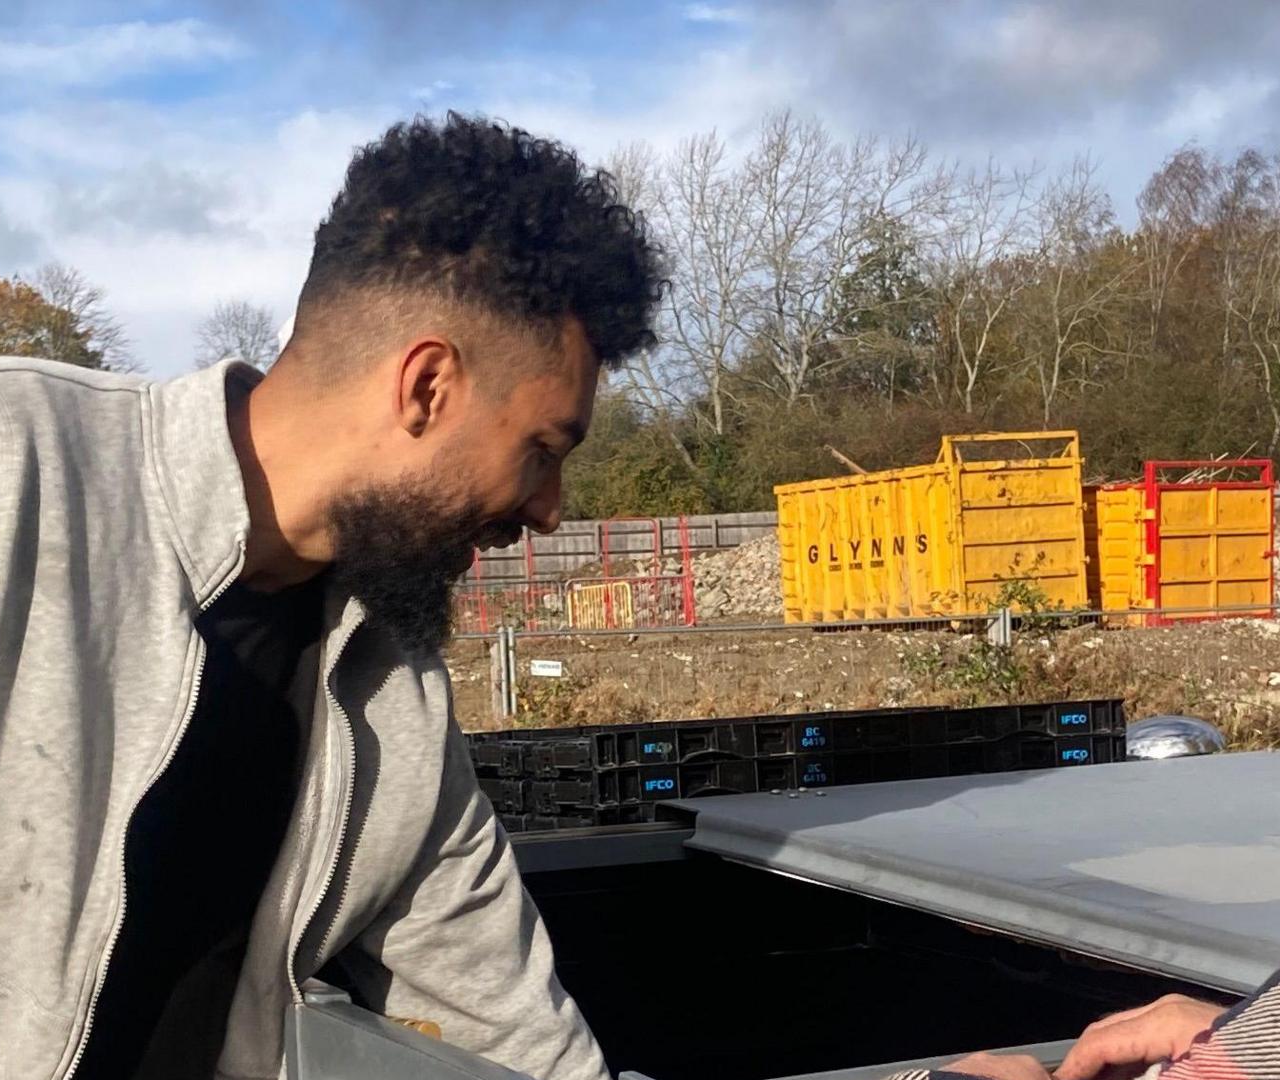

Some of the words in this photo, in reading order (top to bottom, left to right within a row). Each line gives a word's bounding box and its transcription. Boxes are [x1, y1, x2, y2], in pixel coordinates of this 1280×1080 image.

[1061, 714, 1087, 724] IFCO
[805, 727, 821, 737] BC
[1062, 750, 1088, 760] IFCO
[645, 779, 674, 790] IFCO
